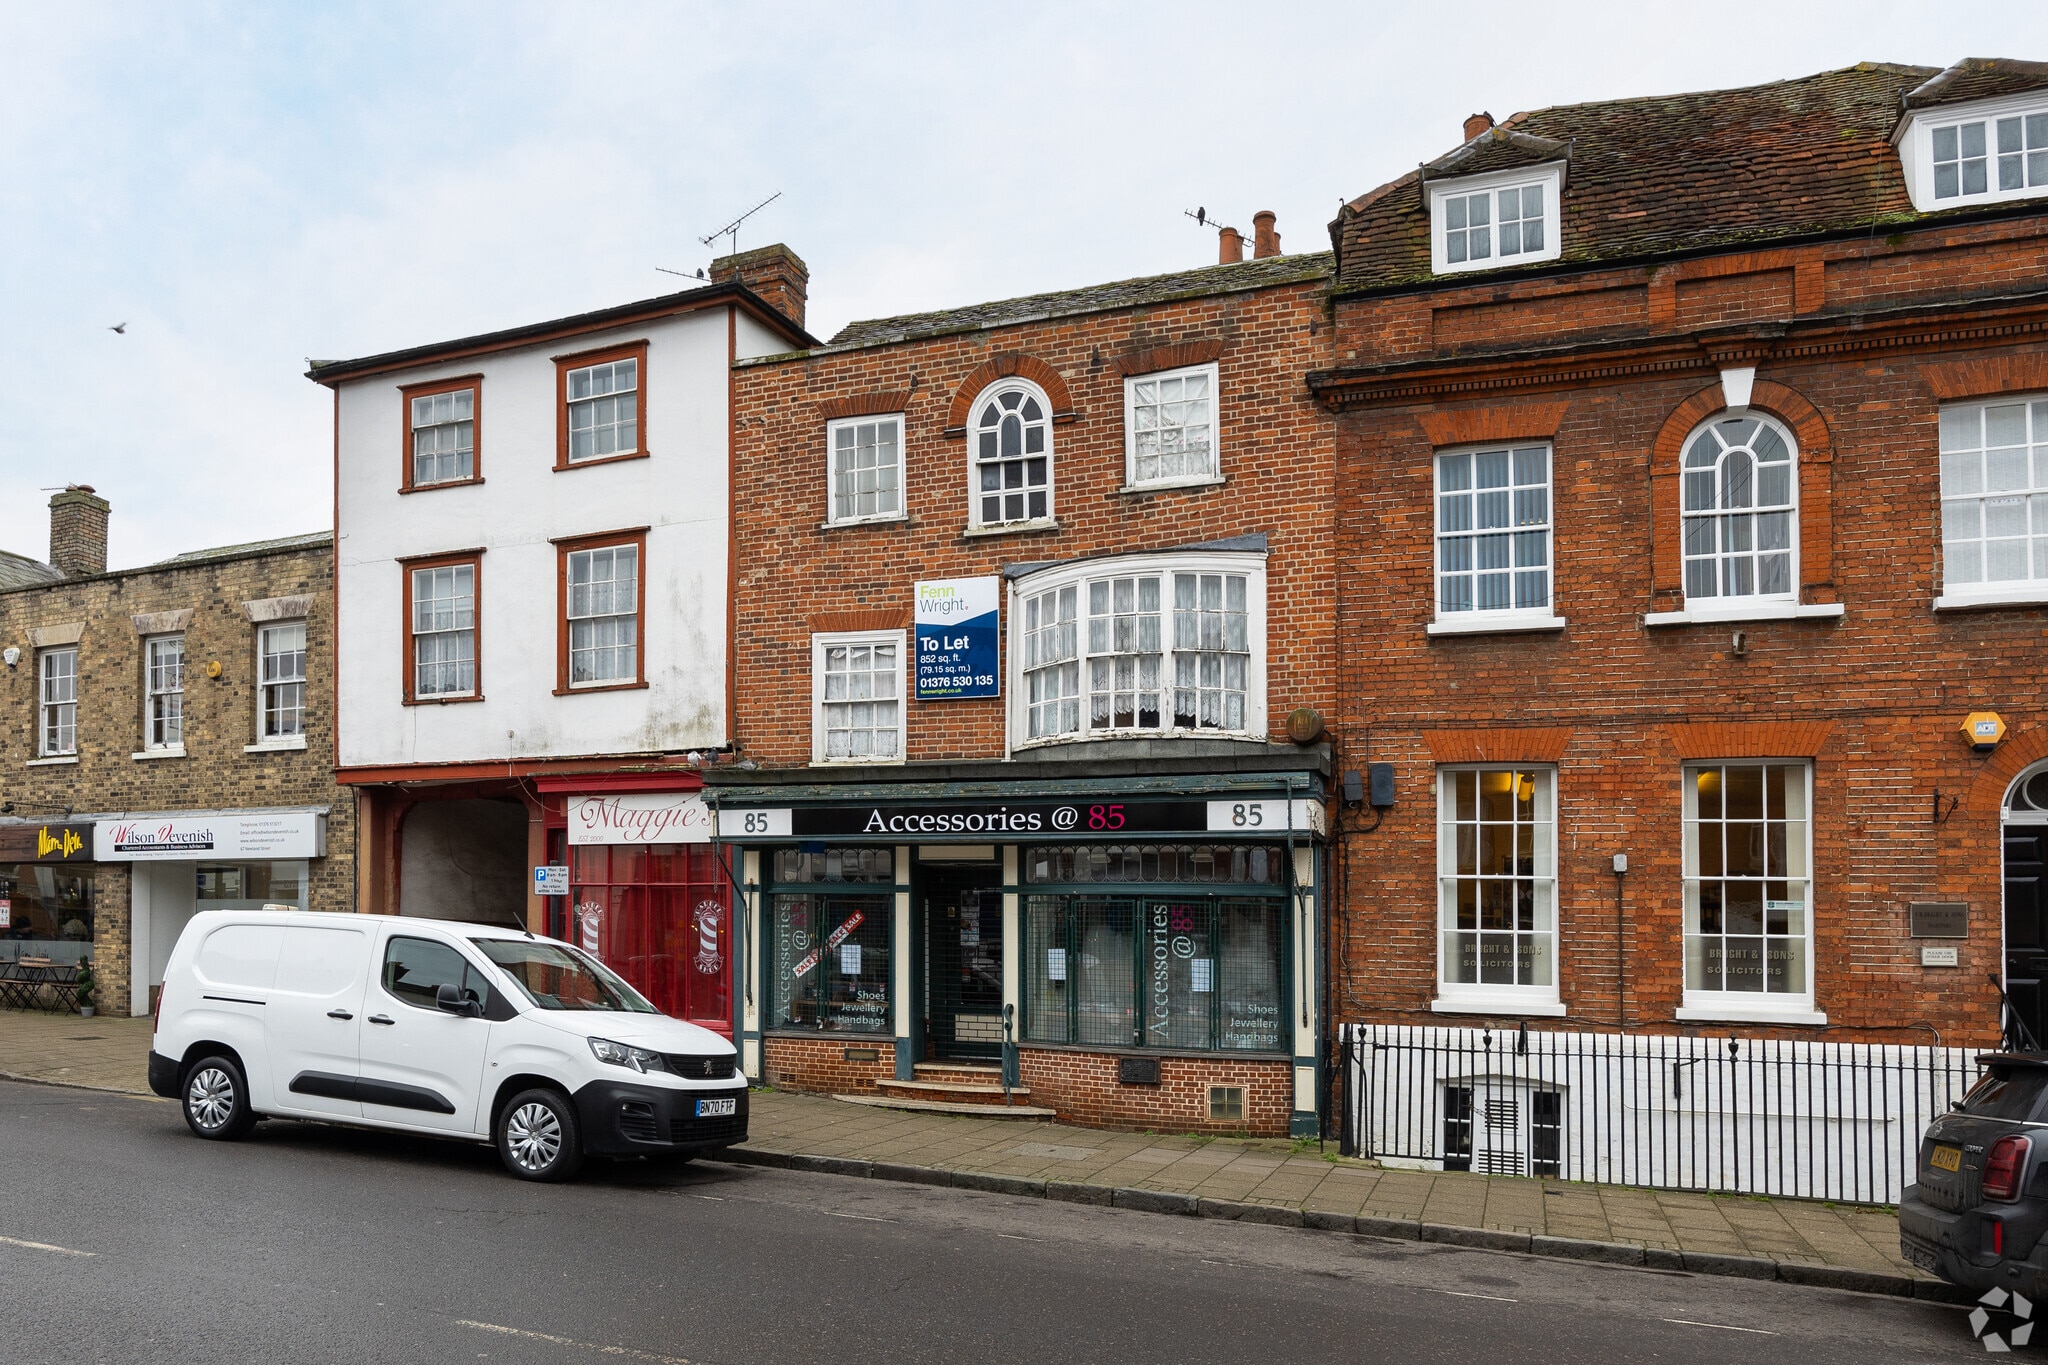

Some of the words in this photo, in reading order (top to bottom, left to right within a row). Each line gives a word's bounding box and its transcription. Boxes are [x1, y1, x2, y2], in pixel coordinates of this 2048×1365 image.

[920, 586, 954, 598] Fenn
[920, 636, 939, 651] To
[944, 636, 969, 650] Let
[920, 654, 936, 663] 852
[938, 656, 951, 664] sq.
[920, 666, 943, 675] (79.15
[945, 666, 956, 674] sq.
[958, 664, 970, 673] m.)
[920, 677, 950, 688] 01376
[952, 676, 972, 686] 530
[974, 675, 993, 685] 135
[1976, 724, 1996, 732] ADT
[863, 806, 1042, 832] Accessories
[1051, 806, 1078, 830] @
[1088, 804, 1126, 830] 85
[1232, 804, 1262, 827] 85
[744, 812, 768, 833] 85
[109, 823, 155, 843] Wilson
[158, 823, 214, 842] Devenish
[792, 902, 808, 925] 85
[1171, 905, 1193, 931] 85
[793, 930, 810, 950] @
[796, 958, 813, 974] SALE
[845, 913, 862, 930] SALE
[1172, 936, 1196, 959] @
[1504, 944, 1510, 954] &
[1517, 945, 1542, 955] SONS
[777, 902, 790, 1020] Accessories
[1751, 950, 1758, 959] &
[1767, 950, 1795, 960] SONS
[1148, 904, 1169, 1038] Accessories
[1707, 966, 1782, 975] SOLICITORS
[857, 990, 885, 1000] Shoes
[841, 1003, 886, 1014] Jewellery
[1248, 1004, 1278, 1014] Shoes
[837, 1015, 885, 1027] Handbags
[1230, 1018, 1278, 1030] Jewellery
[1225, 1031, 1278, 1044] Handbags
